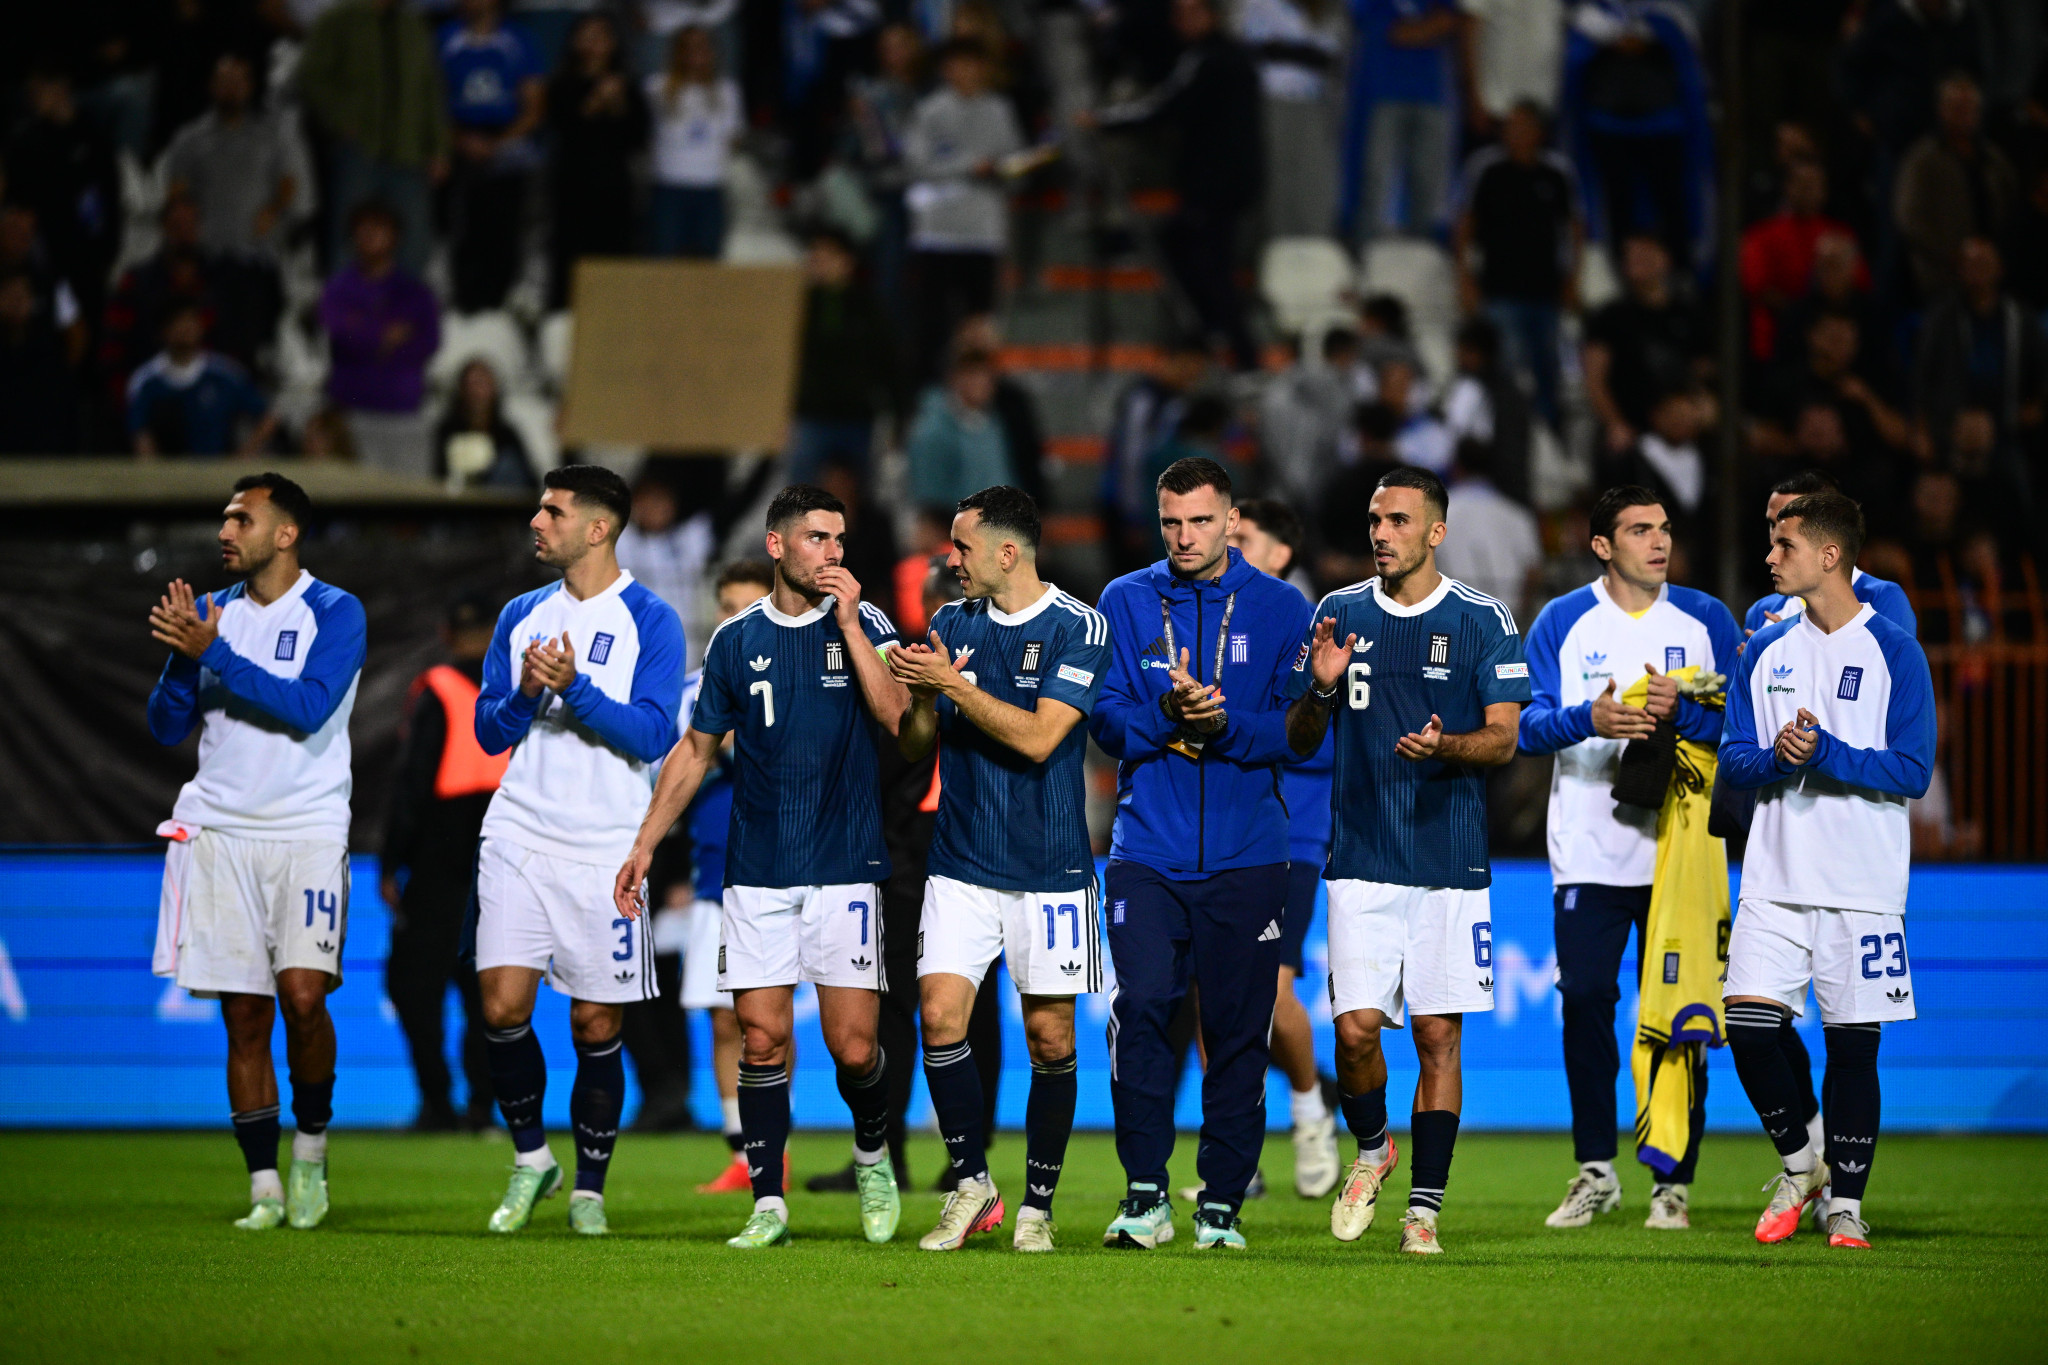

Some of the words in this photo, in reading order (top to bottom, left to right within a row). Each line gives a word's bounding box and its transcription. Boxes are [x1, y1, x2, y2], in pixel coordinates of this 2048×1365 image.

[1150, 661, 1171, 671] allwy
[1347, 662, 1372, 711] 6
[750, 680, 776, 728] 7
[1773, 685, 1796, 694] allwyn
[304, 888, 336, 932] 14
[848, 901, 869, 946] 7
[1042, 903, 1080, 951] 17
[612, 917, 634, 962] 3
[1471, 921, 1492, 968] 6
[1860, 932, 1907, 980] 23
[1761, 1106, 1787, 1118] ΛΑΣ
[743, 1140, 767, 1150] ΛΑΣ
[944, 1134, 966, 1144] ΛΑΣ
[1833, 1135, 1874, 1144] ΕΛΛΑΣ
[1028, 1159, 1062, 1171] ΕΛΛΑΣ
